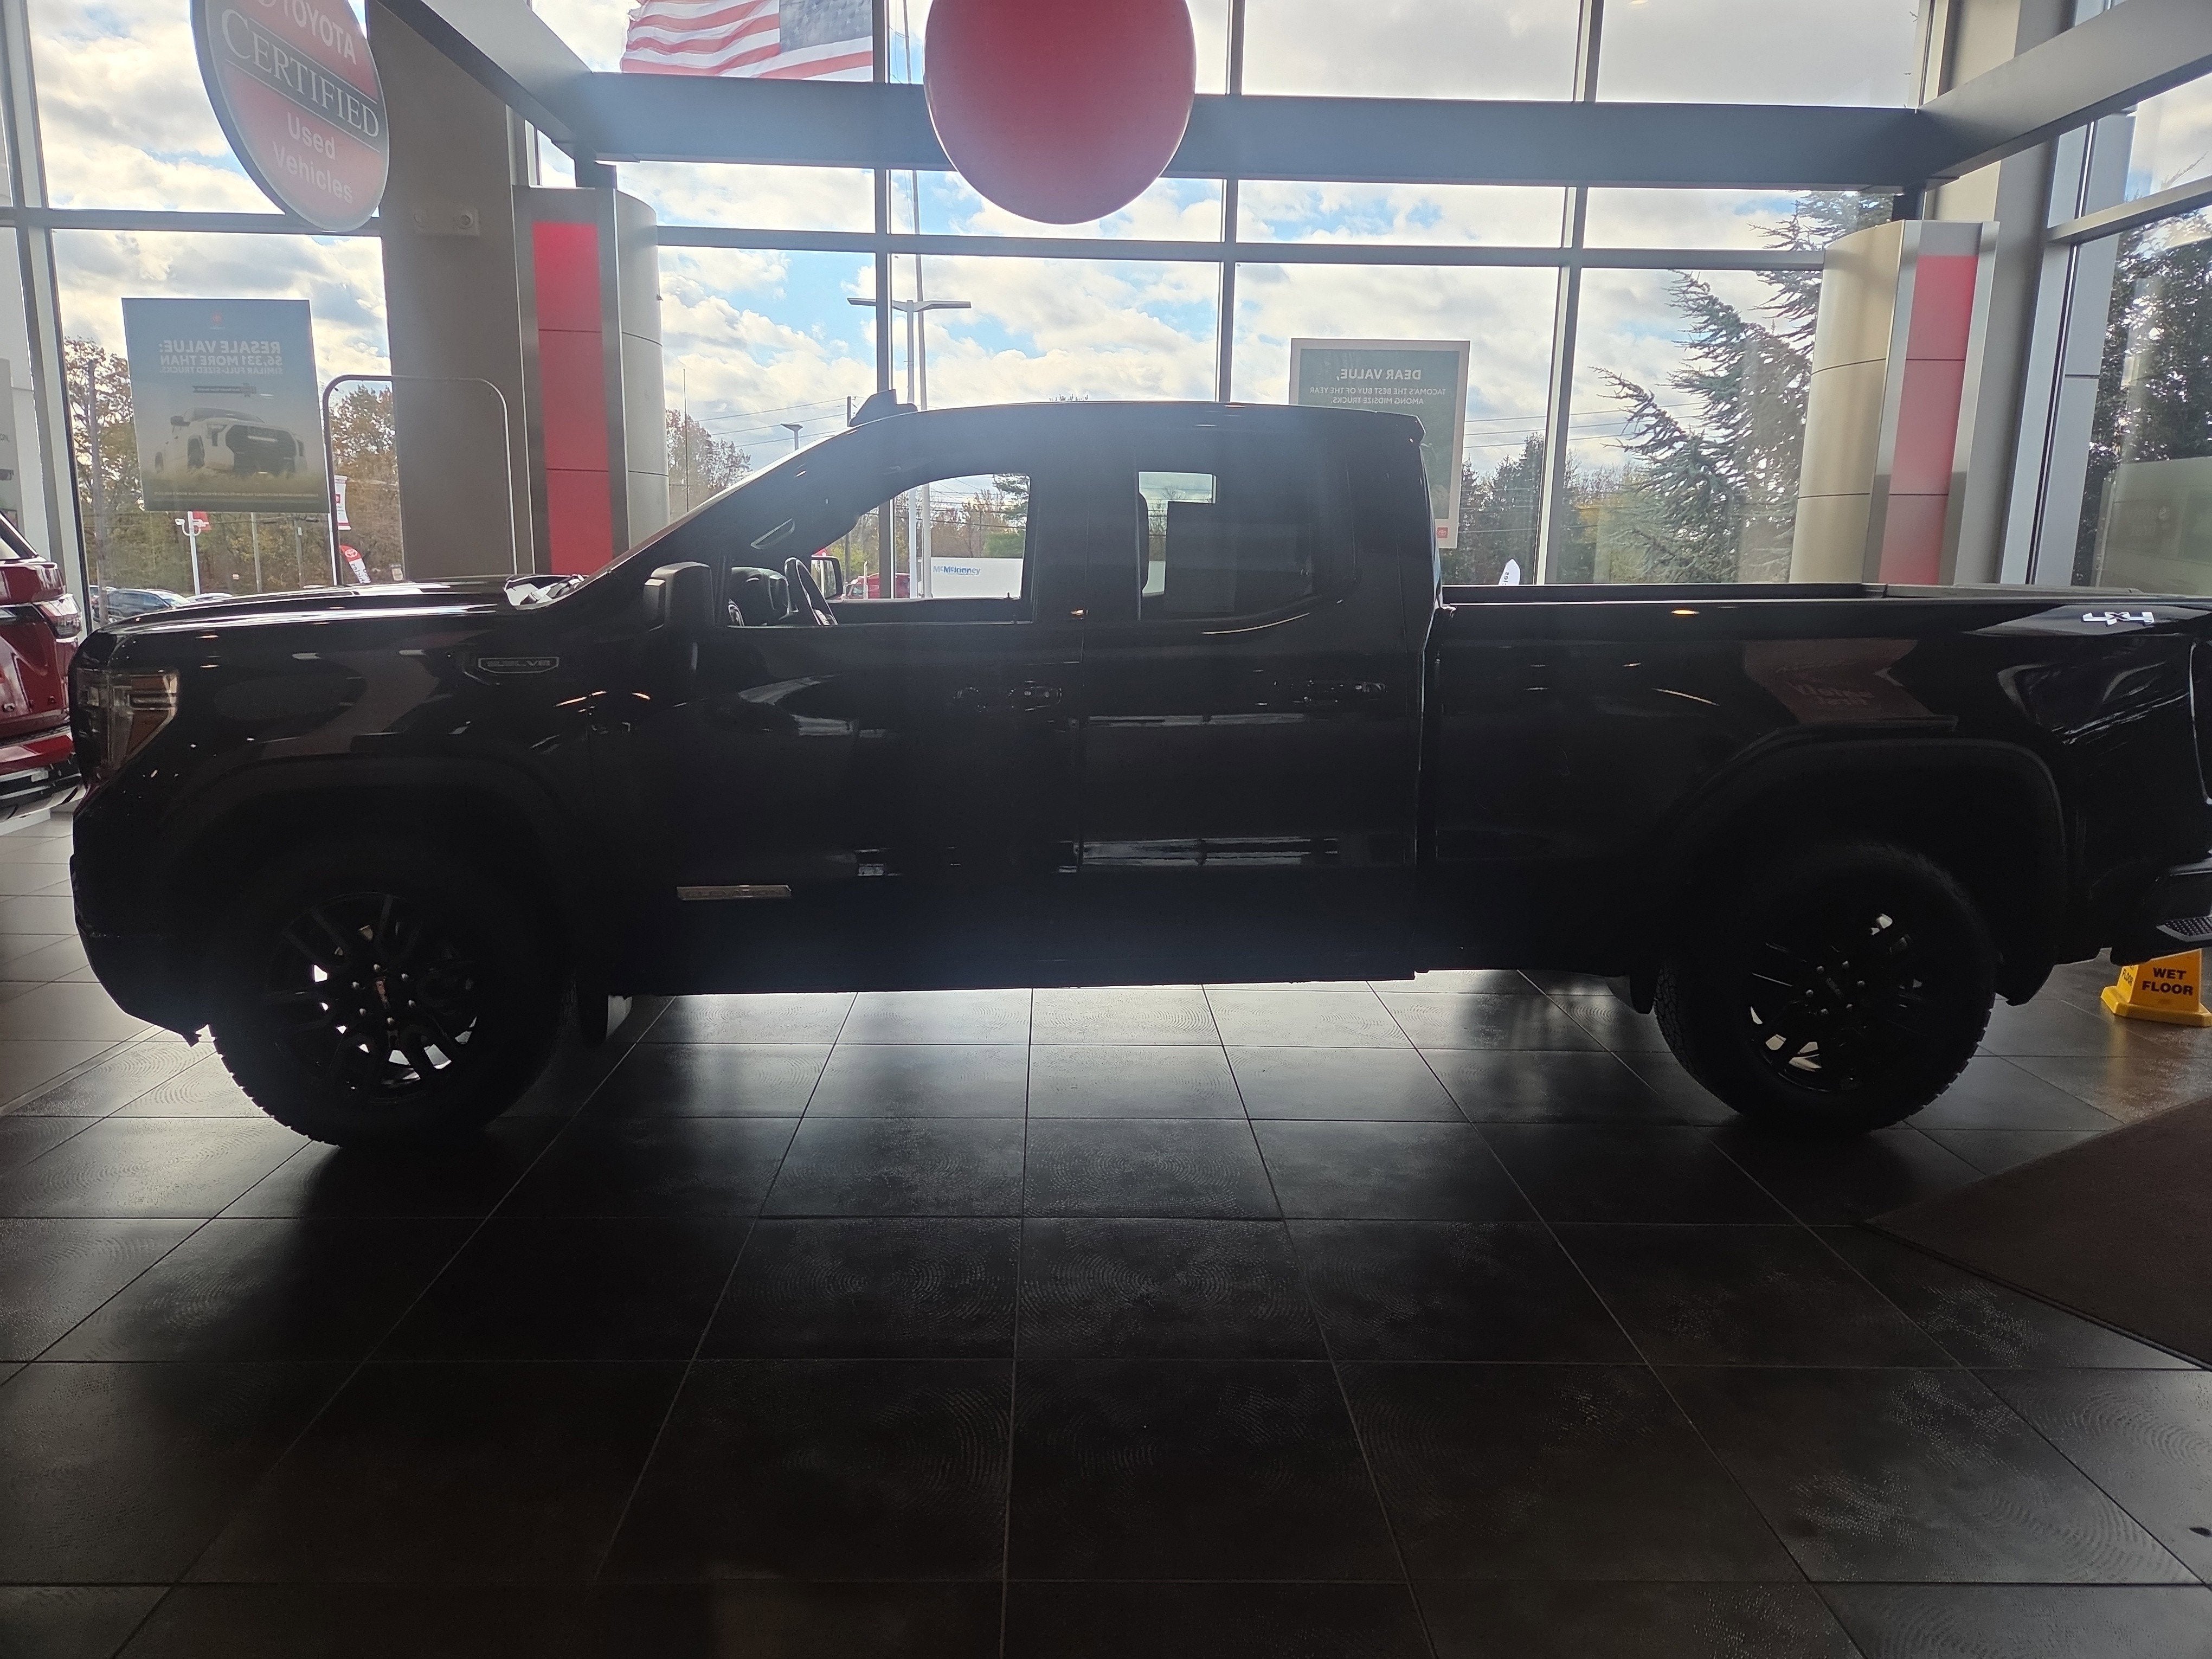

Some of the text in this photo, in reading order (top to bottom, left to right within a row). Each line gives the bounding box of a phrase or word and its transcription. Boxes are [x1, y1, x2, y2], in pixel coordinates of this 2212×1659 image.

[222, 9, 379, 138] CERTIFIED
[287, 111, 336, 160] Used
[272, 141, 353, 203] Vehicles
[2142, 981, 2194, 995] FLOOR
[2153, 967, 2187, 980] WET
